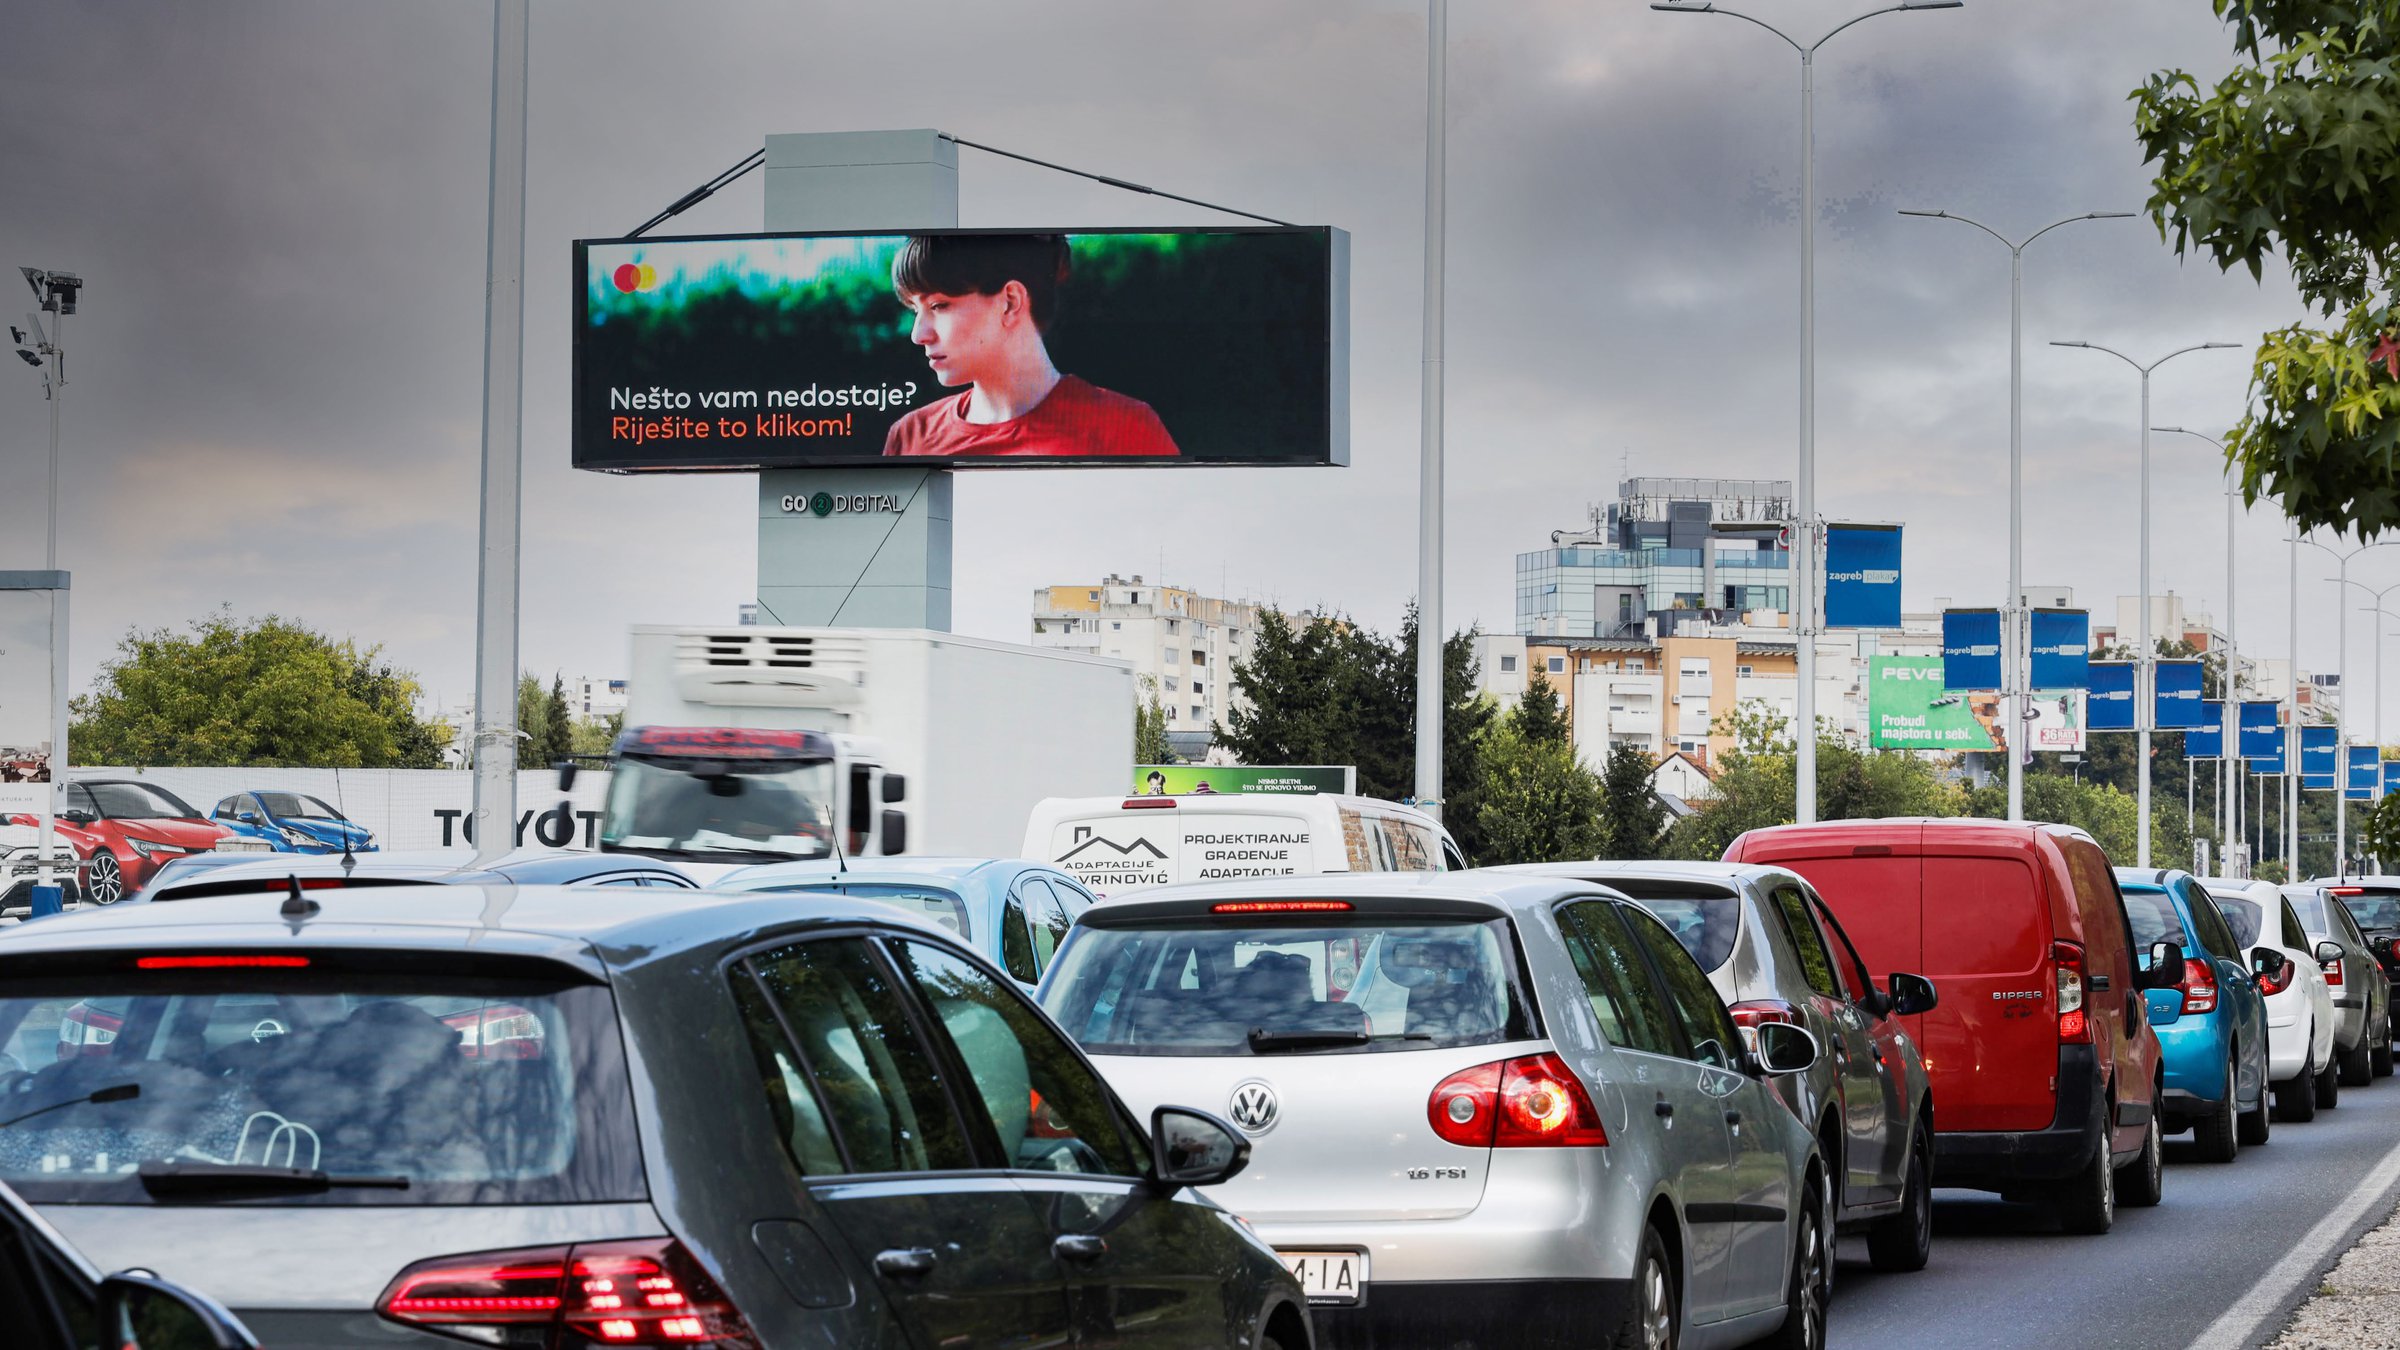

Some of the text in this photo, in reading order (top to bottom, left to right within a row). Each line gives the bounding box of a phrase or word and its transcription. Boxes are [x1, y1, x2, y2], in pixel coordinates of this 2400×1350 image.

[610, 381, 917, 412] Nešto vam nedostaje?
[612, 413, 852, 445] Riješite to klikom!
[781, 494, 808, 513] GO
[835, 494, 903, 513] DIGITAL
[1829, 570, 1894, 582] zagreb plakat
[1945, 645, 1971, 655] zagreb
[2032, 645, 2059, 655] zagreb
[1882, 667, 1944, 681] PEVE
[2158, 690, 2179, 699] zagreb
[1881, 714, 1926, 727] Probudi
[1881, 727, 1972, 741] majstora u sebi.
[2043, 729, 2058, 741] 36
[434, 809, 605, 848] TYOT
[1184, 833, 1310, 845] PROJEKTIRANJE
[1205, 850, 1289, 861] GRAĐENJE
[1064, 860, 1155, 870] ADAPTACIJE
[1074, 870, 1168, 885] VRINOVIĆ
[1199, 867, 1295, 879] ADAPTACIJE
[1992, 990, 2043, 1000] BIPPER
[1435, 1166, 1467, 1179] FSI
